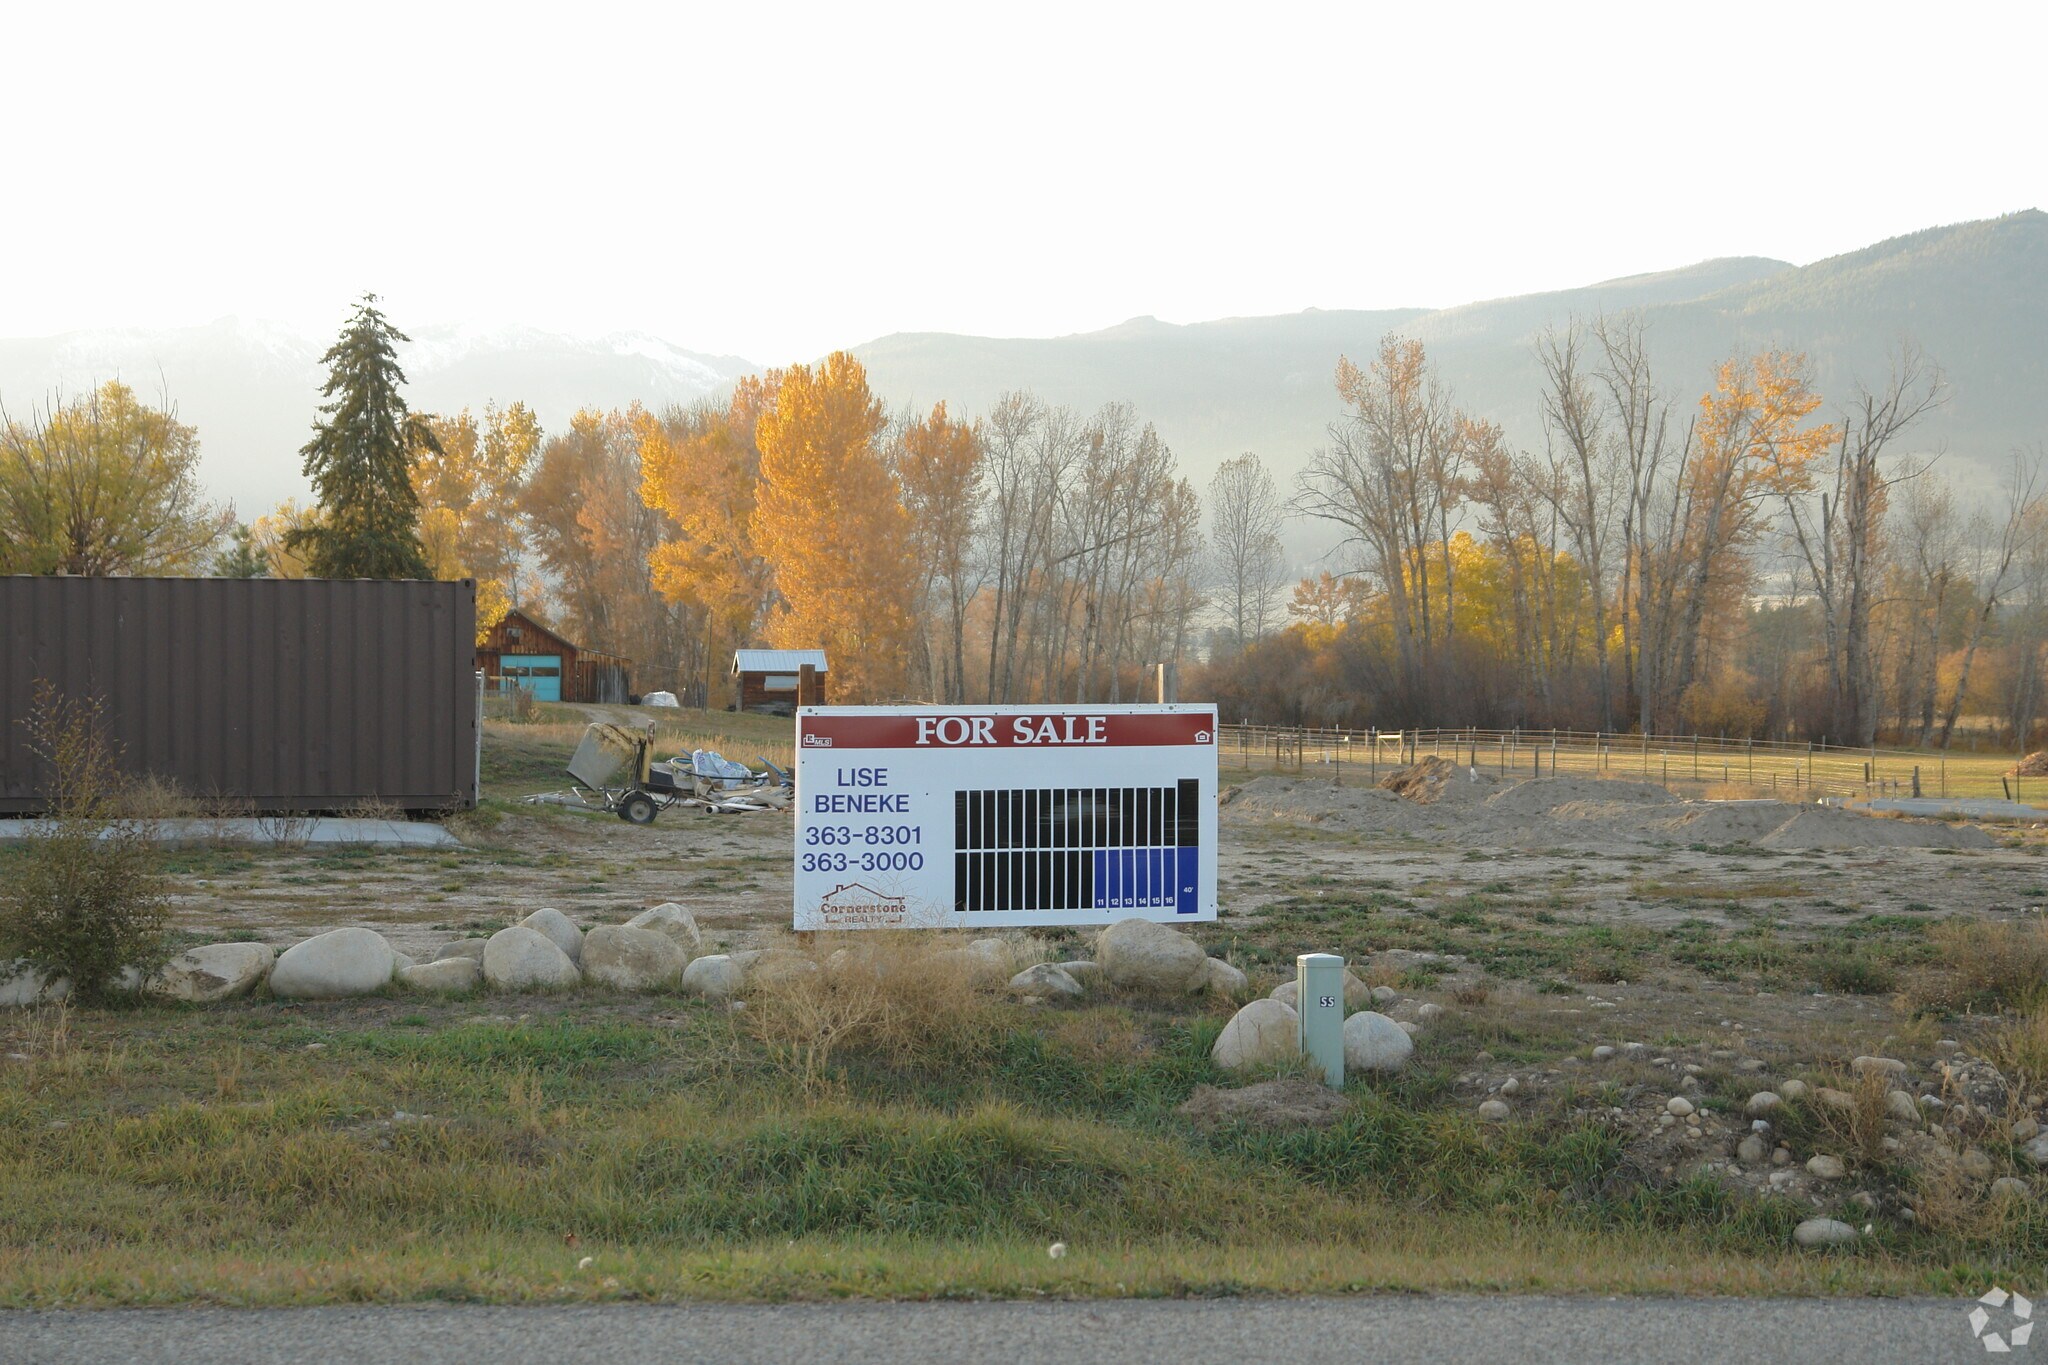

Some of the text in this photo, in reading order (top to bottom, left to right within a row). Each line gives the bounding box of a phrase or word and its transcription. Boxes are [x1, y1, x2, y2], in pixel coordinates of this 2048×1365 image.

[916, 716, 1108, 745] FOR SALE
[837, 768, 888, 787] LISE
[815, 794, 910, 813] BENEKE
[806, 826, 921, 846] 363-8301
[802, 852, 924, 872] 363-3000
[1138, 897, 1147, 905] 14
[1165, 896, 1173, 904] 16
[821, 903, 906, 914] Cornerstone
[844, 915, 882, 923] REALTY
[1321, 997, 1335, 1006] SS
